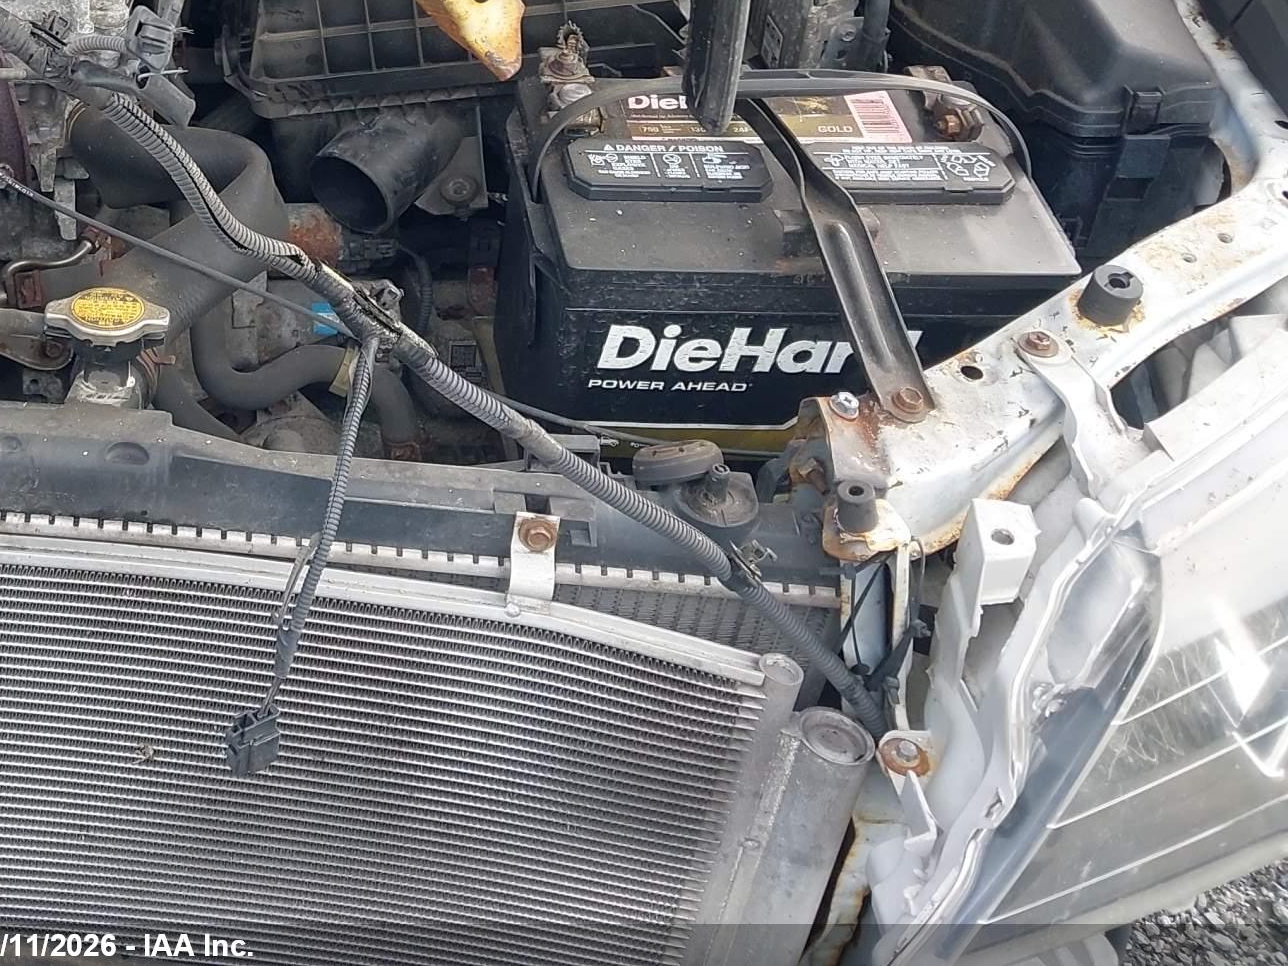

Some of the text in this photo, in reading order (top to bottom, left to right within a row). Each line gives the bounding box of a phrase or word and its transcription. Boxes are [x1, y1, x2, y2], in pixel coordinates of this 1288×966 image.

[817, 125, 853, 133] GOLD
[616, 144, 667, 152] DANGER
[678, 145, 725, 153] POISON
[588, 379, 747, 392] POWER AHEAD
